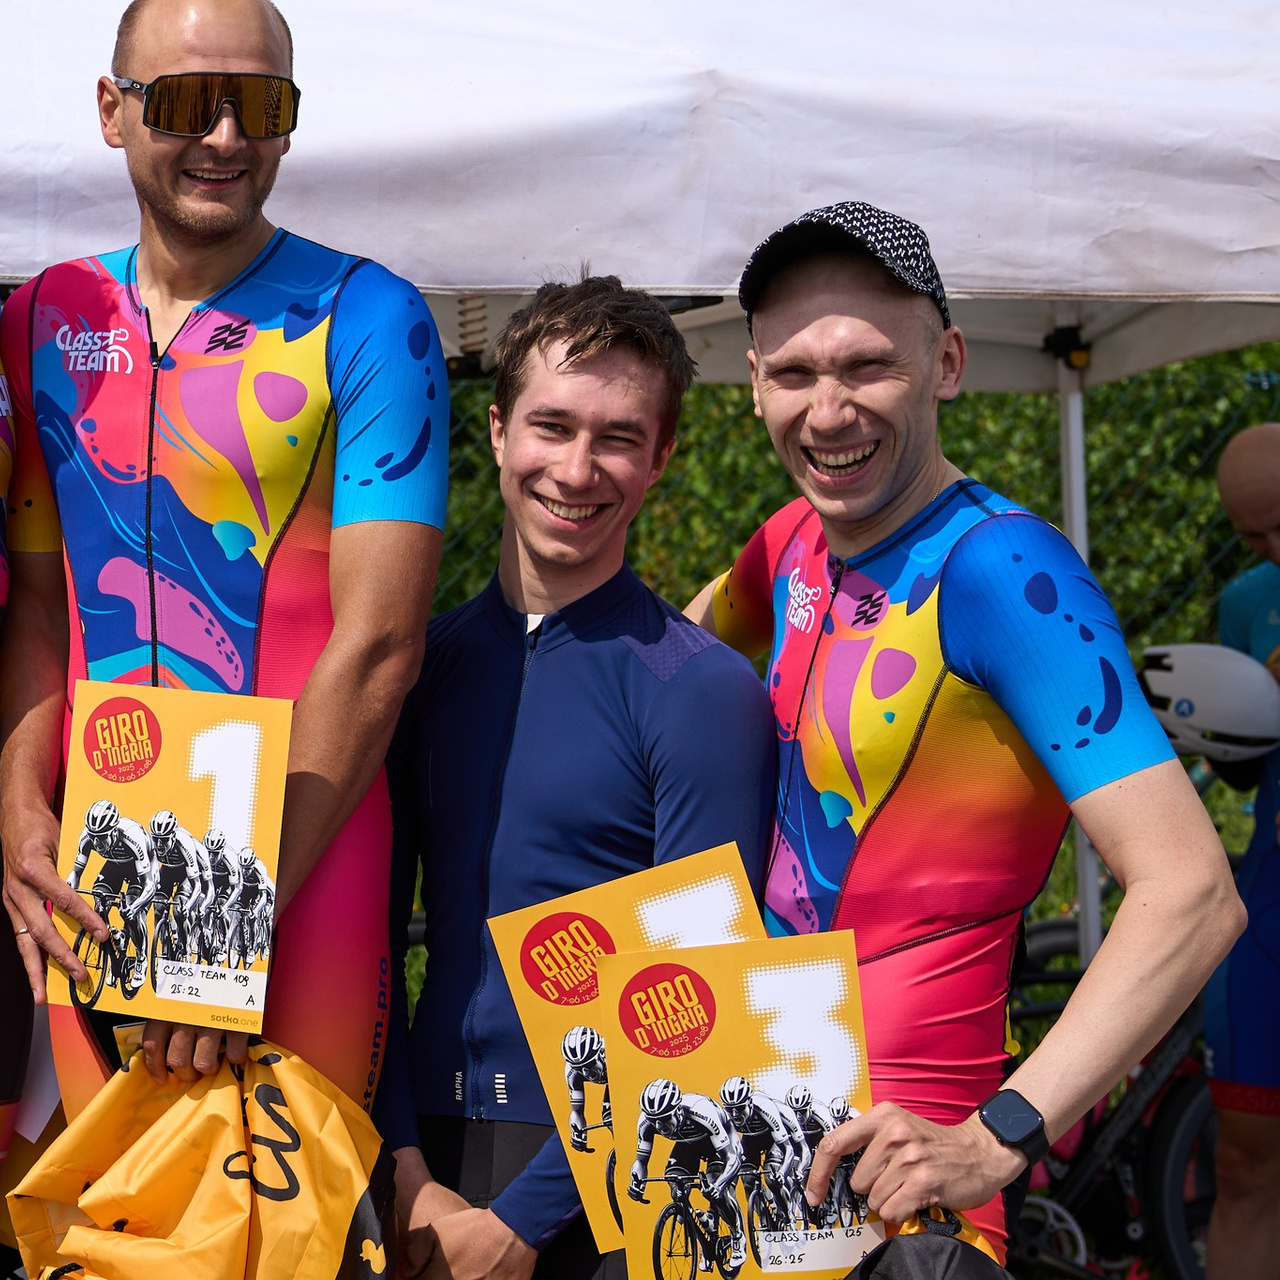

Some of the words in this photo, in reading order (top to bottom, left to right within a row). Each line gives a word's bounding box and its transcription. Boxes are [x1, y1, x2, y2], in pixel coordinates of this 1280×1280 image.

[95, 709, 150, 750] GIRO
[118, 763, 136, 773] 2025
[185, 716, 264, 850] 1
[530, 919, 598, 978] GIRO
[163, 965, 194, 977] CLASS
[201, 970, 227, 980] TEAM
[171, 984, 201, 998] 25:22
[577, 979, 596, 993] 2025
[630, 973, 700, 1027] GIRO
[669, 1034, 689, 1047] 2025
[739, 954, 864, 1107] 3
[455, 1070, 463, 1101] RAPHA
[765, 1232, 800, 1243] CLASS
[803, 1230, 835, 1242] TEAM
